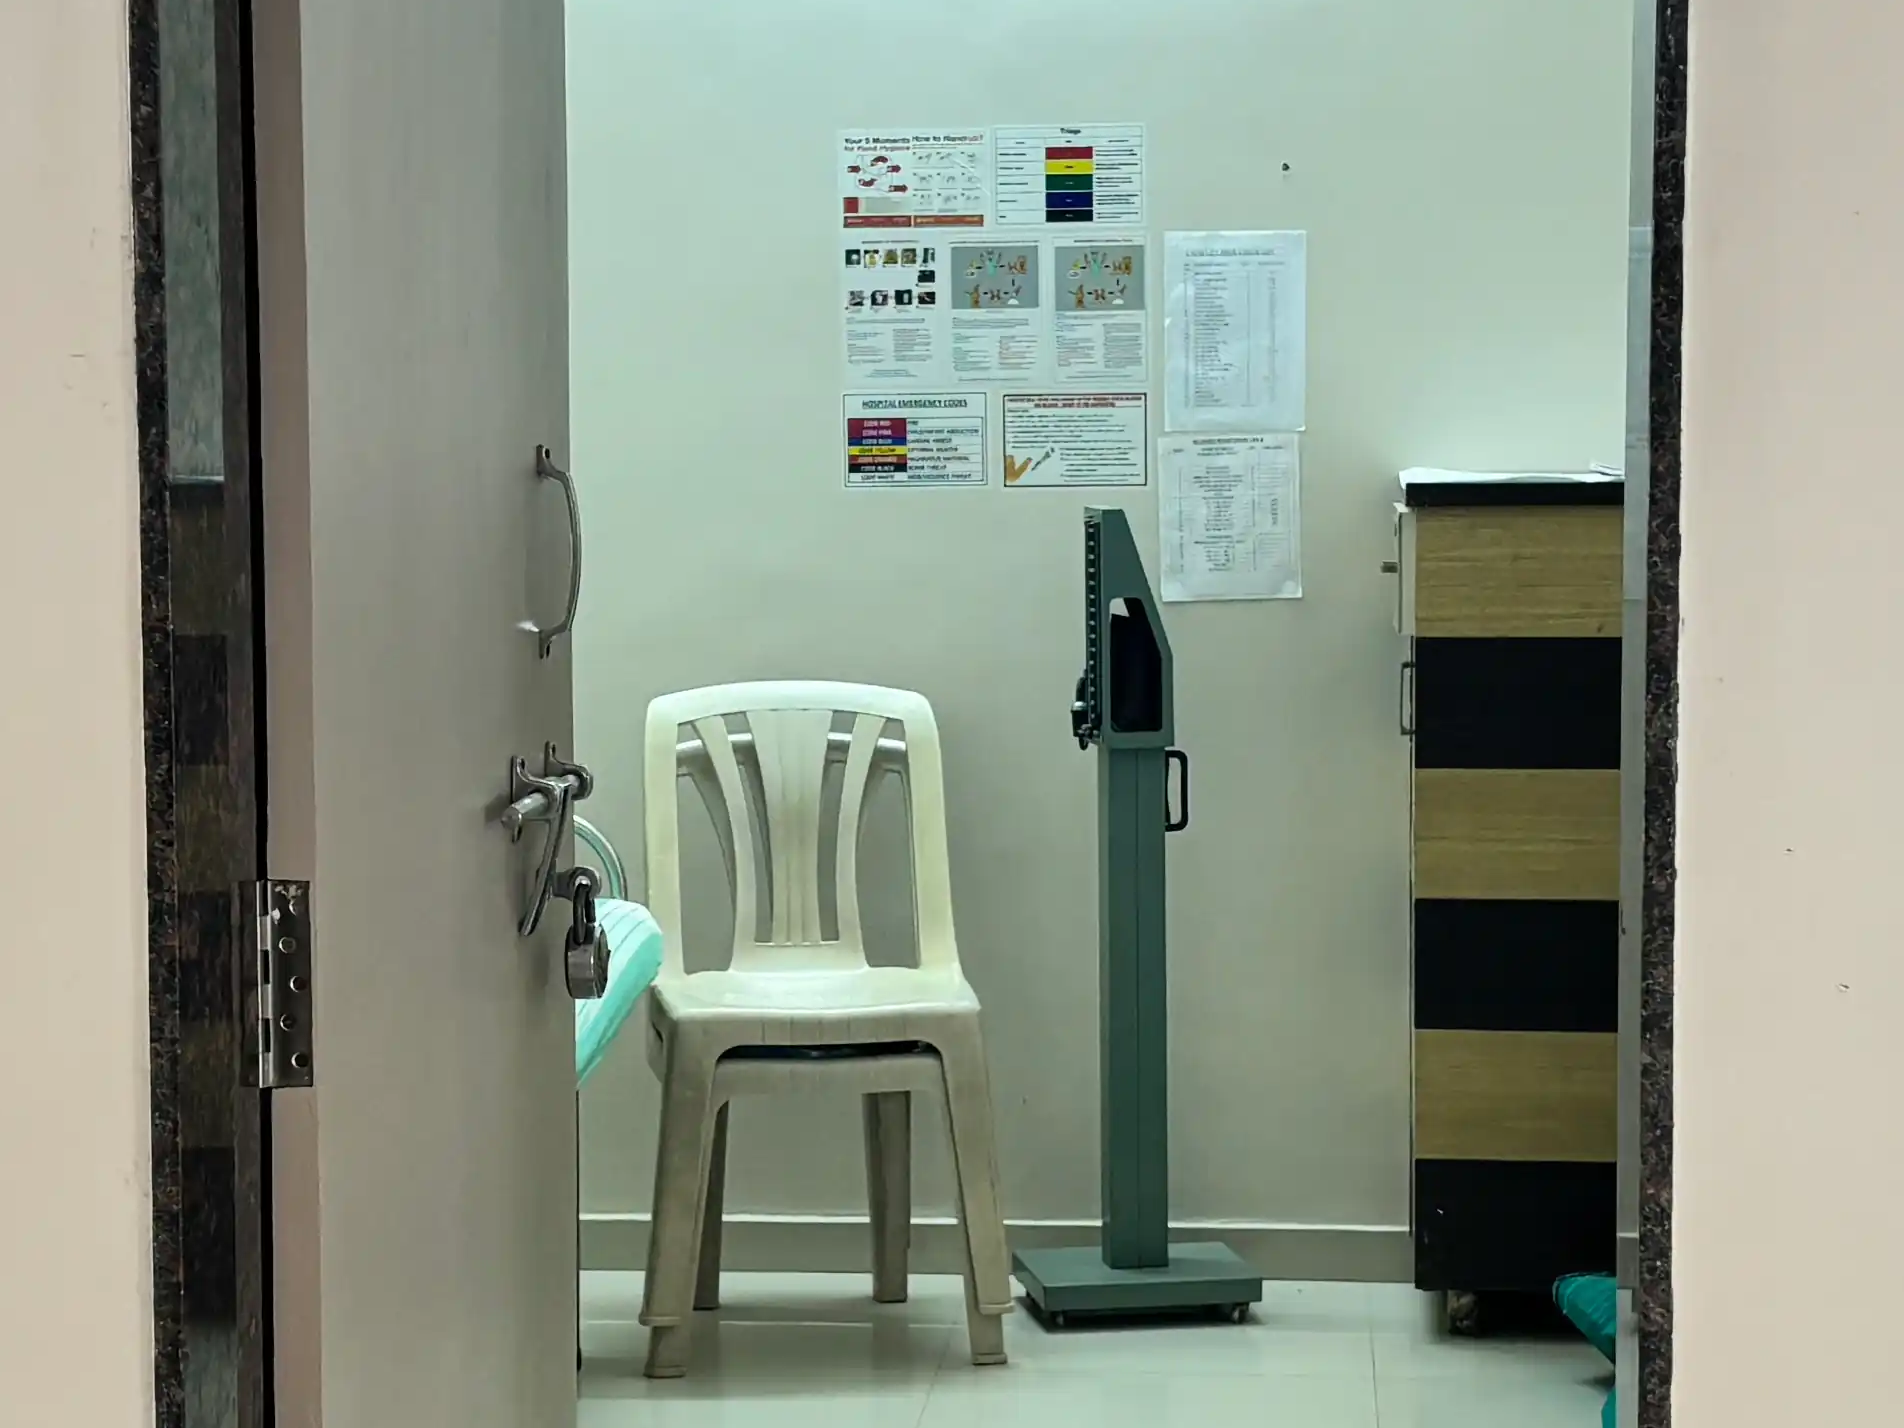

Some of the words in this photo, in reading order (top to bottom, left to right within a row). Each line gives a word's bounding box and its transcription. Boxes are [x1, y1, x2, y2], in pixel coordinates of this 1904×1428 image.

[1059, 127, 1082, 135] Triage
[862, 399, 897, 409] HOSPITAL
[898, 399, 942, 408] EMERGENCY
[943, 399, 968, 408] CODES
